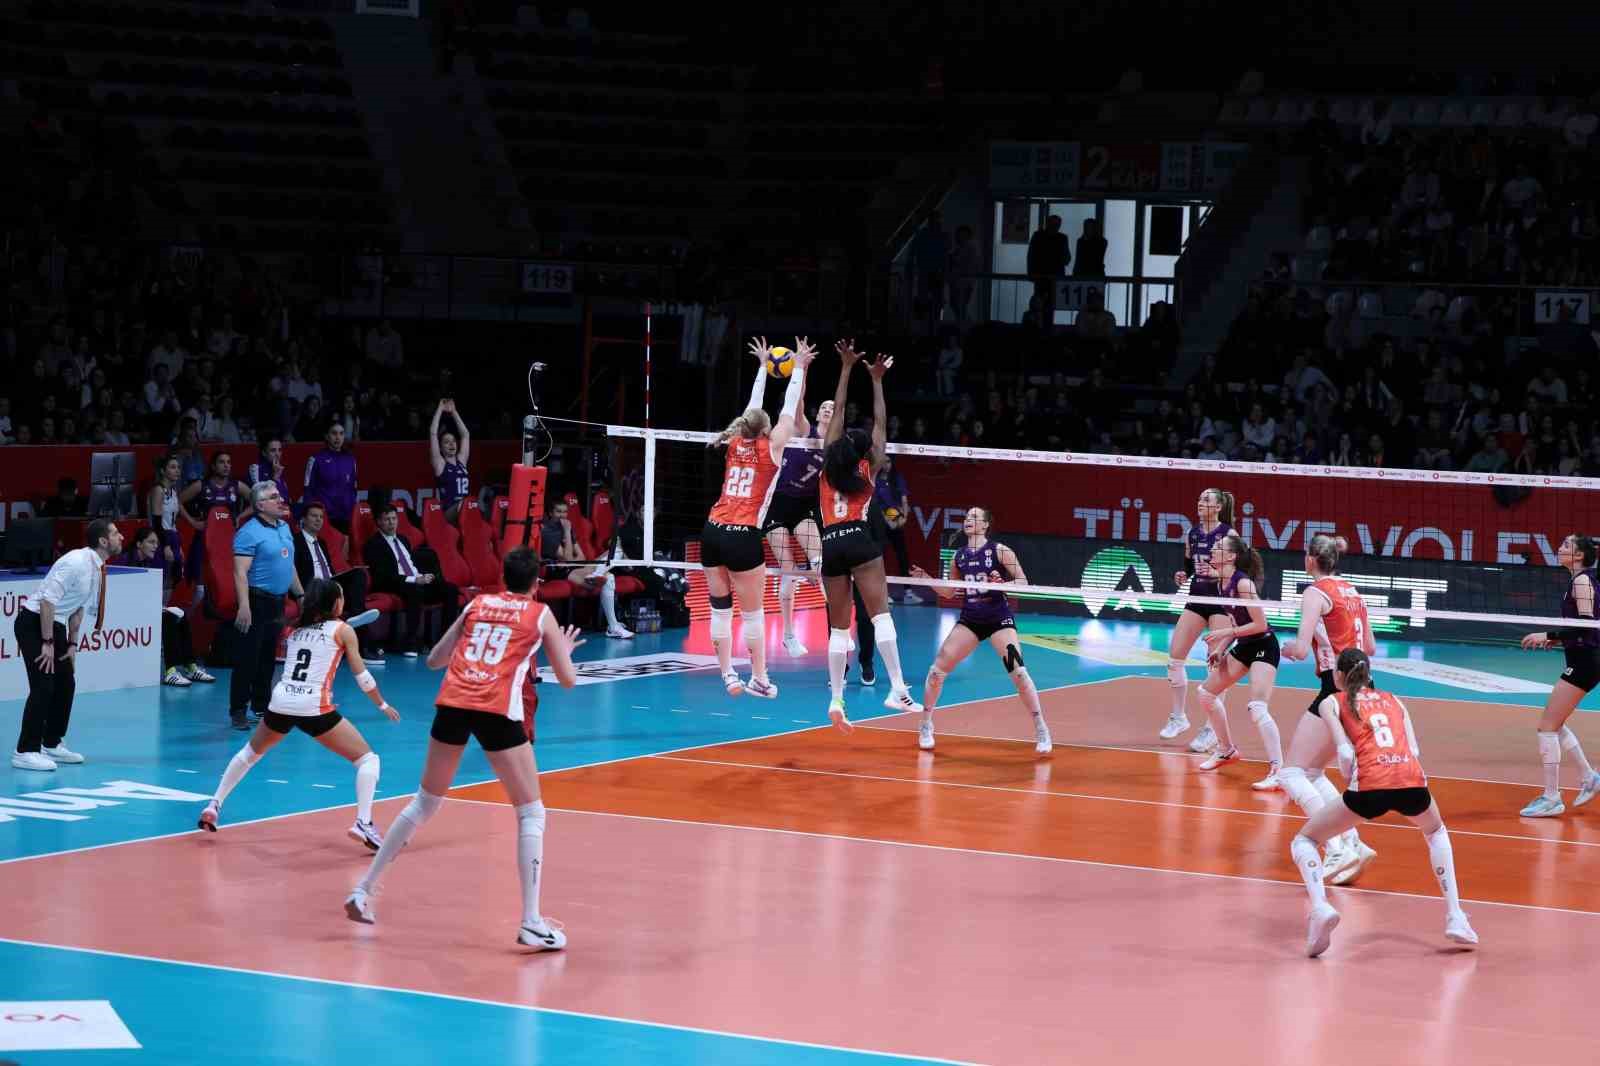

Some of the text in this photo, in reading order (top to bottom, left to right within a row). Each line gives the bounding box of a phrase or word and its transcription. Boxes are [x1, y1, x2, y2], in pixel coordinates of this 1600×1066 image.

[527, 268, 568, 289] 119
[1540, 297, 1583, 319] 117
[726, 466, 755, 498] 22
[76, 625, 152, 654] ASYONU
[291, 648, 312, 682] 2
[1369, 712, 1395, 749] 6
